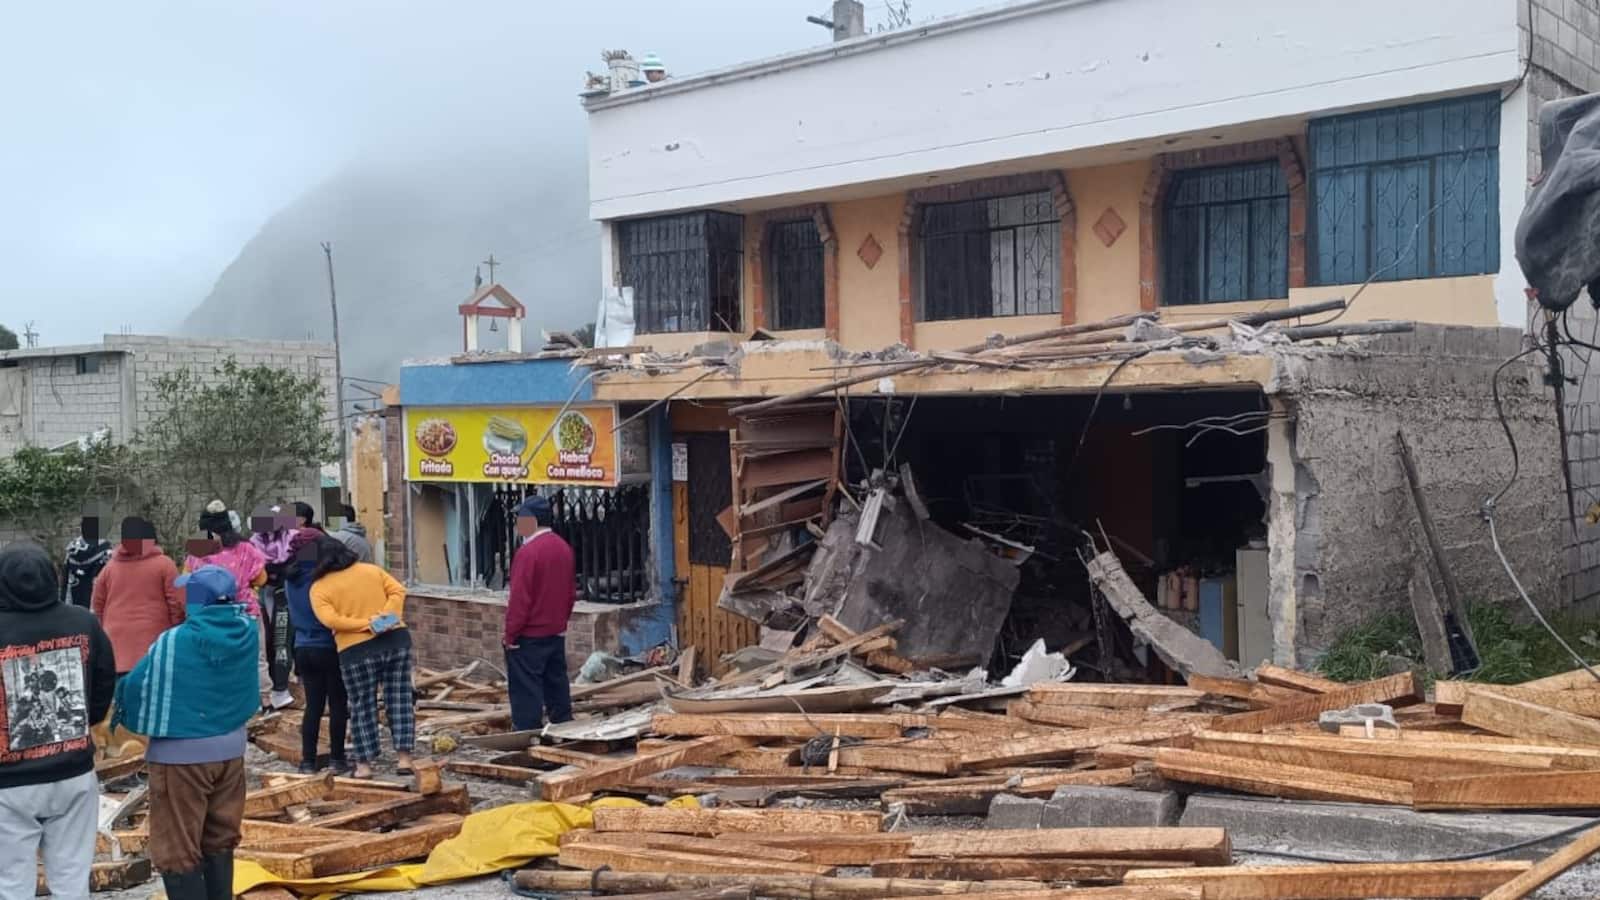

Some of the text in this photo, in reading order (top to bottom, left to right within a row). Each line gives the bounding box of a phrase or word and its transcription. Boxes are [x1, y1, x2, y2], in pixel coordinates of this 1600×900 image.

[560, 451, 590, 464] Habas
[420, 460, 452, 473] Fritada
[484, 464, 500, 475] Con
[547, 465, 603, 479] Con melloco
